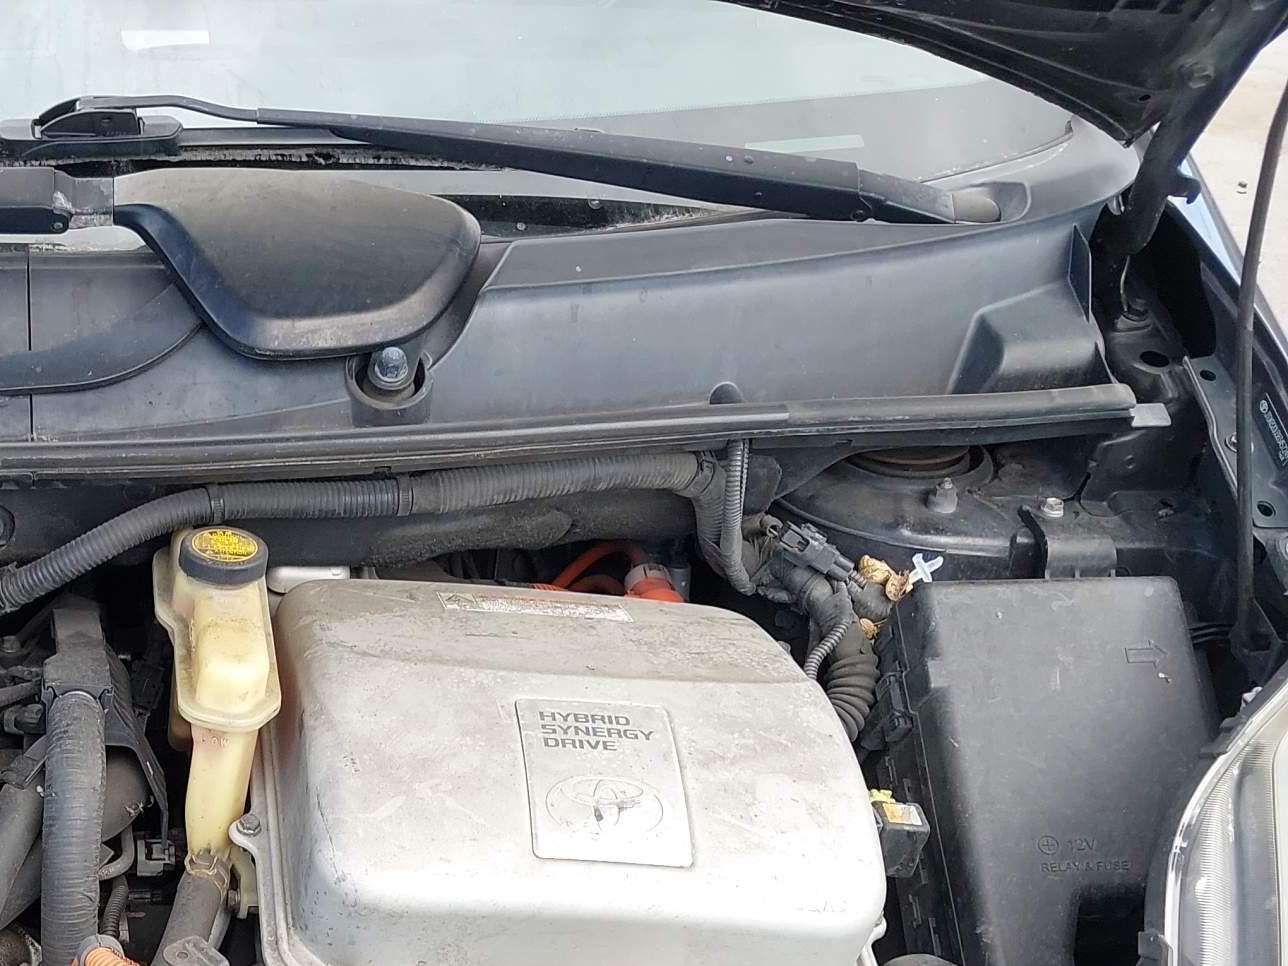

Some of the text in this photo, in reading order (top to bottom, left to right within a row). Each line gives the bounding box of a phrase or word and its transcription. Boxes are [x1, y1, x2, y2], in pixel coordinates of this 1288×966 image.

[538, 711, 631, 726] HYBRID
[540, 724, 655, 741] SYNERGY
[543, 737, 618, 751] DRIVE
[1040, 861, 1080, 873] RELAY
[1096, 859, 1129, 872] FUSE
